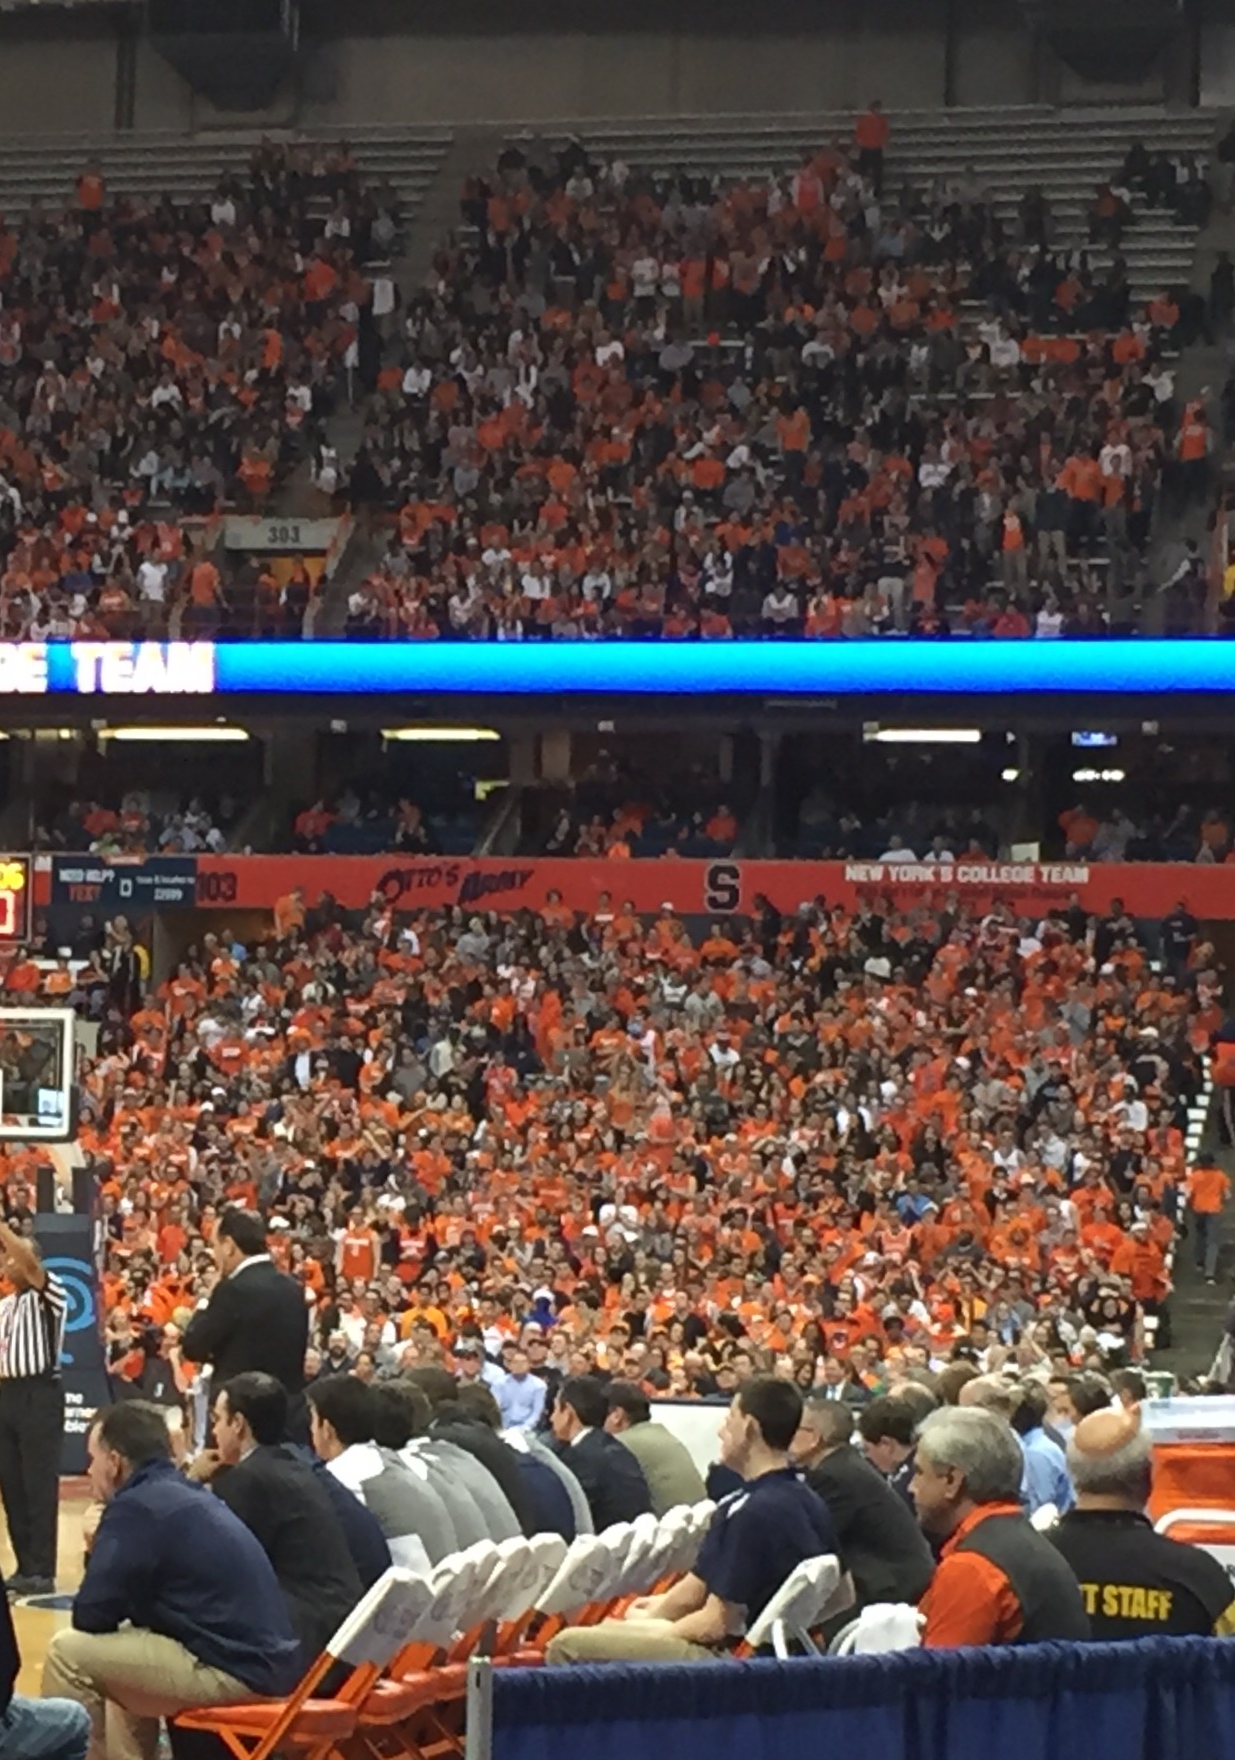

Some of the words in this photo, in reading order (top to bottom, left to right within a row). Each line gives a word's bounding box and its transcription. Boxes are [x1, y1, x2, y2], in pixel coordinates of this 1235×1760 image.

[71, 641, 214, 692] TEAM
[846, 865, 883, 881] NEW
[888, 865, 953, 882] YORK'S
[957, 866, 1035, 883] COLLEGE
[1040, 866, 1089, 883] TEAM
[1103, 1585, 1173, 1620] STAFF
